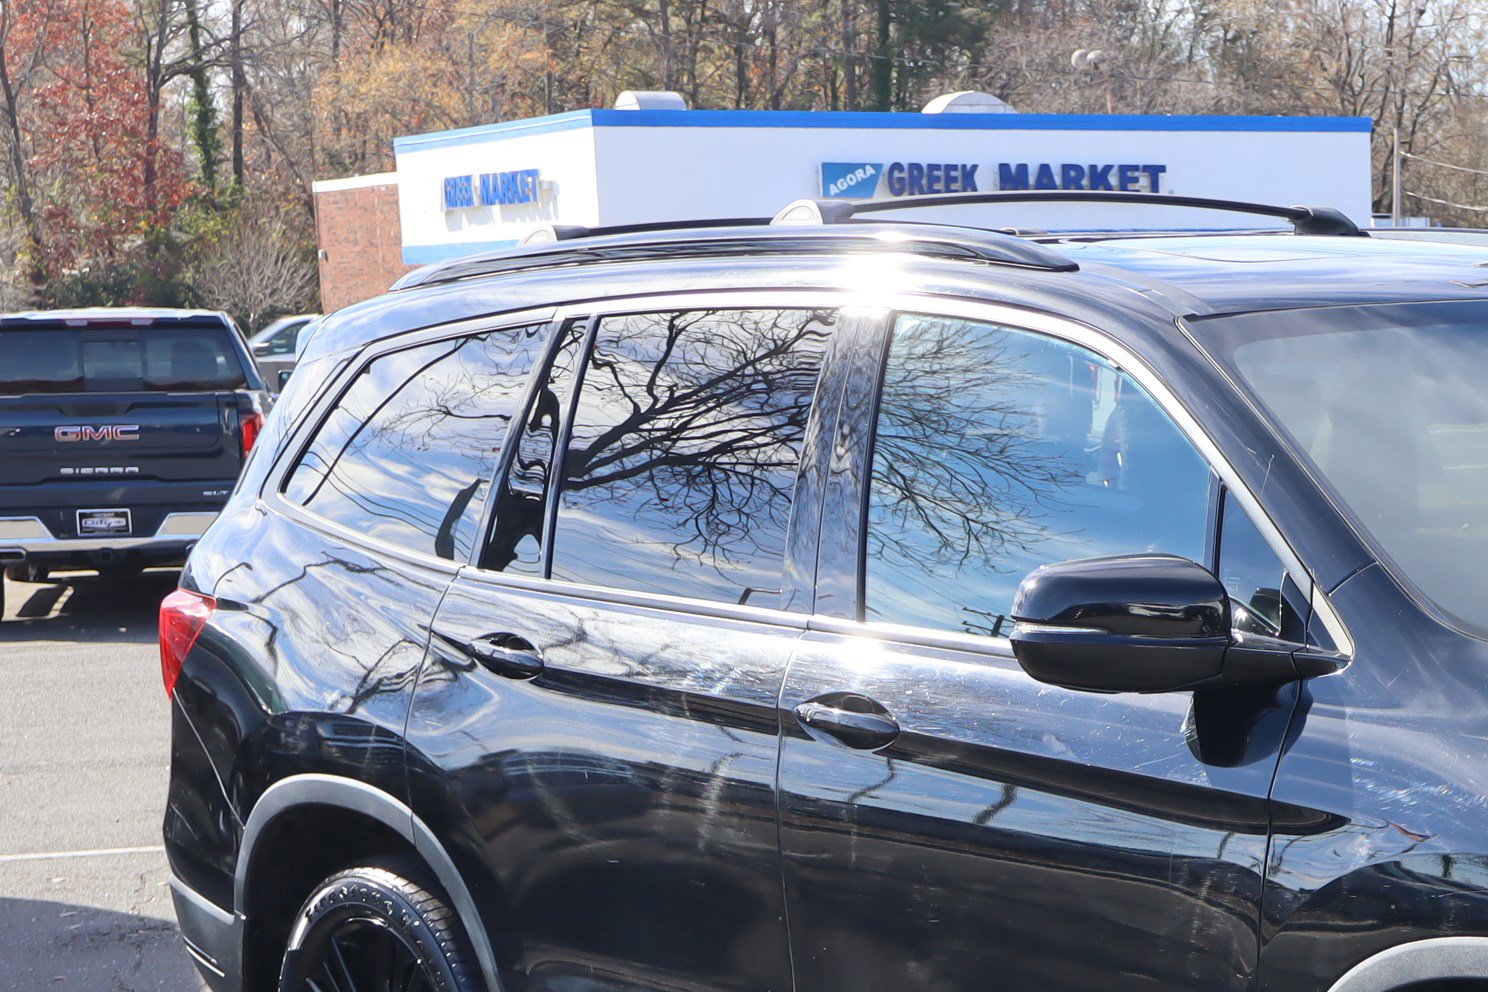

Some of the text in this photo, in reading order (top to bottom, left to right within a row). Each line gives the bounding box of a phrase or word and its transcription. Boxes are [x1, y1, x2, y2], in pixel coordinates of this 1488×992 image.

[479, 168, 540, 206] MARKET
[828, 163, 876, 196] AGORA
[887, 161, 1167, 196] GREEK MARKET
[54, 424, 140, 442] GMC
[60, 466, 139, 474] SIERRA
